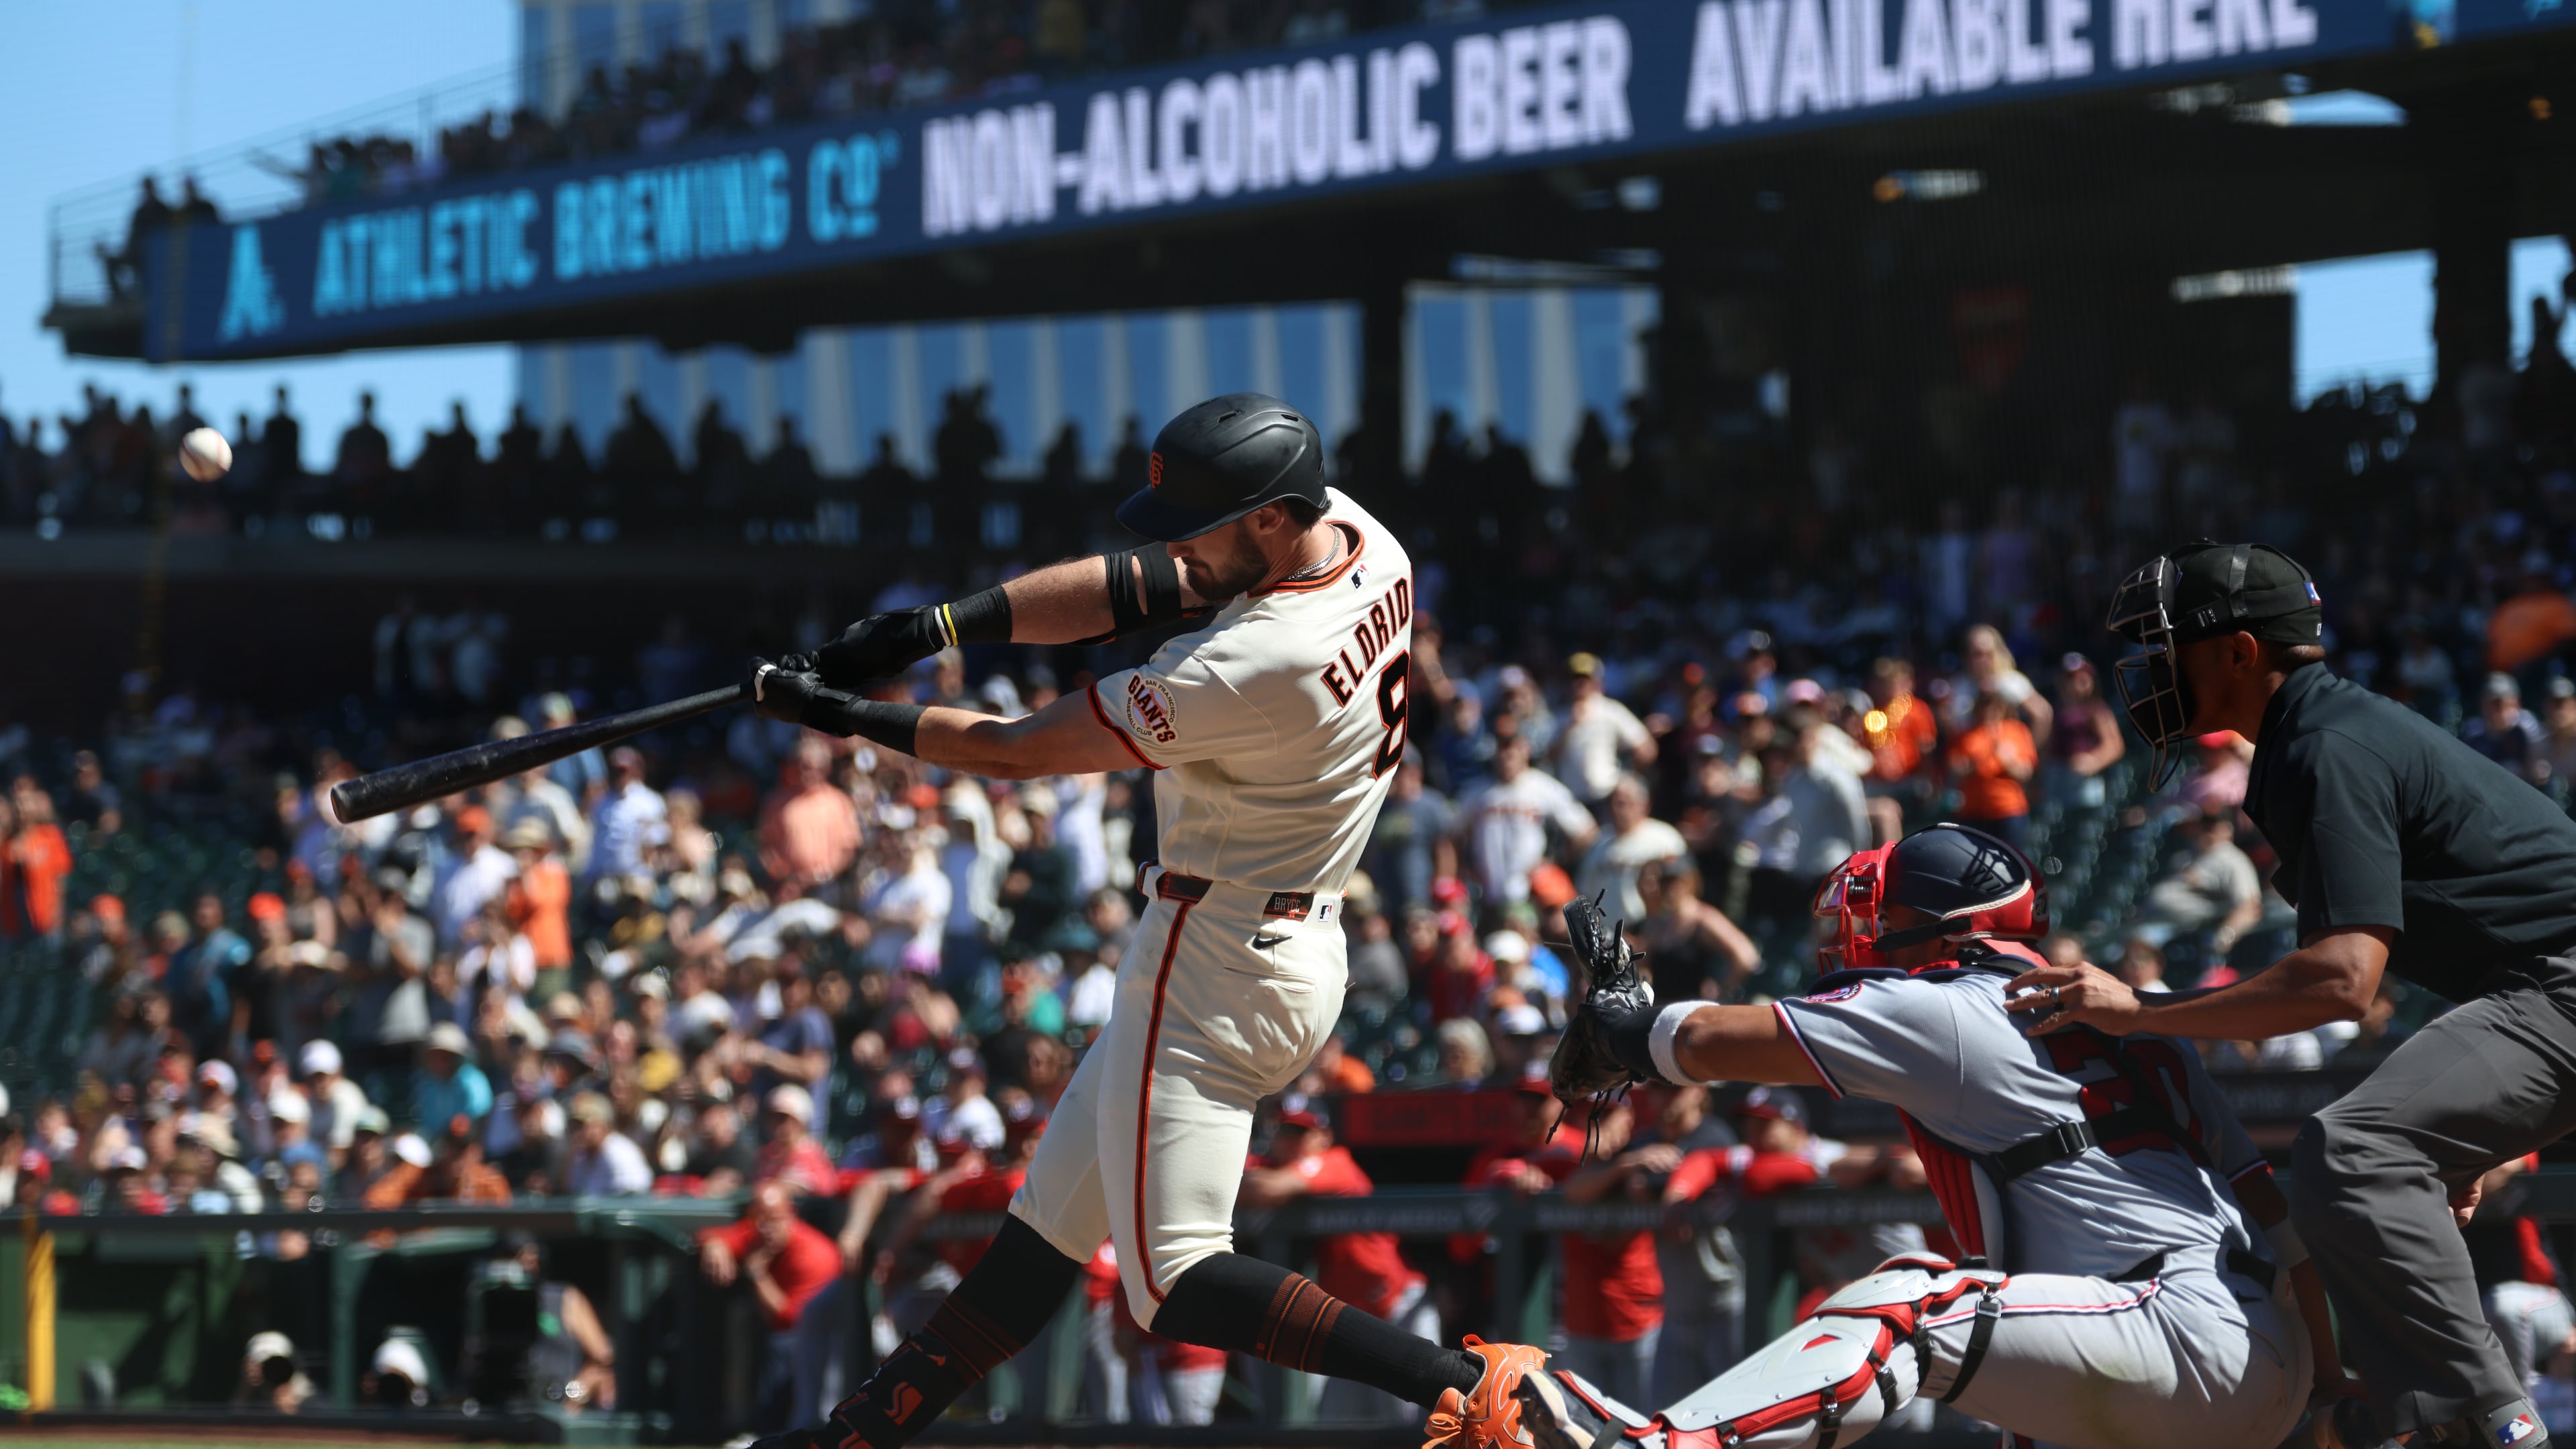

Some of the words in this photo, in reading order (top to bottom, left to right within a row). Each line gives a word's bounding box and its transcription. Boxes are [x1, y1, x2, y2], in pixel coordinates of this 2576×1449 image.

[922, 42, 1440, 237] NON-ALCOHOLIC
[1453, 15, 1633, 160] BEER
[1685, 0, 2094, 130] AVAILABLE
[313, 191, 537, 316] ATHLETIC
[553, 148, 790, 279] BREWING
[1321, 576, 1413, 708] ELDRID
[1126, 696, 1136, 729] BASEBALL
[1136, 727, 1152, 736] CLUB
[1128, 675, 1176, 743] GIANTS
[1158, 684, 1175, 722] FRANCISCO
[1275, 897, 1301, 912] BRYCE
